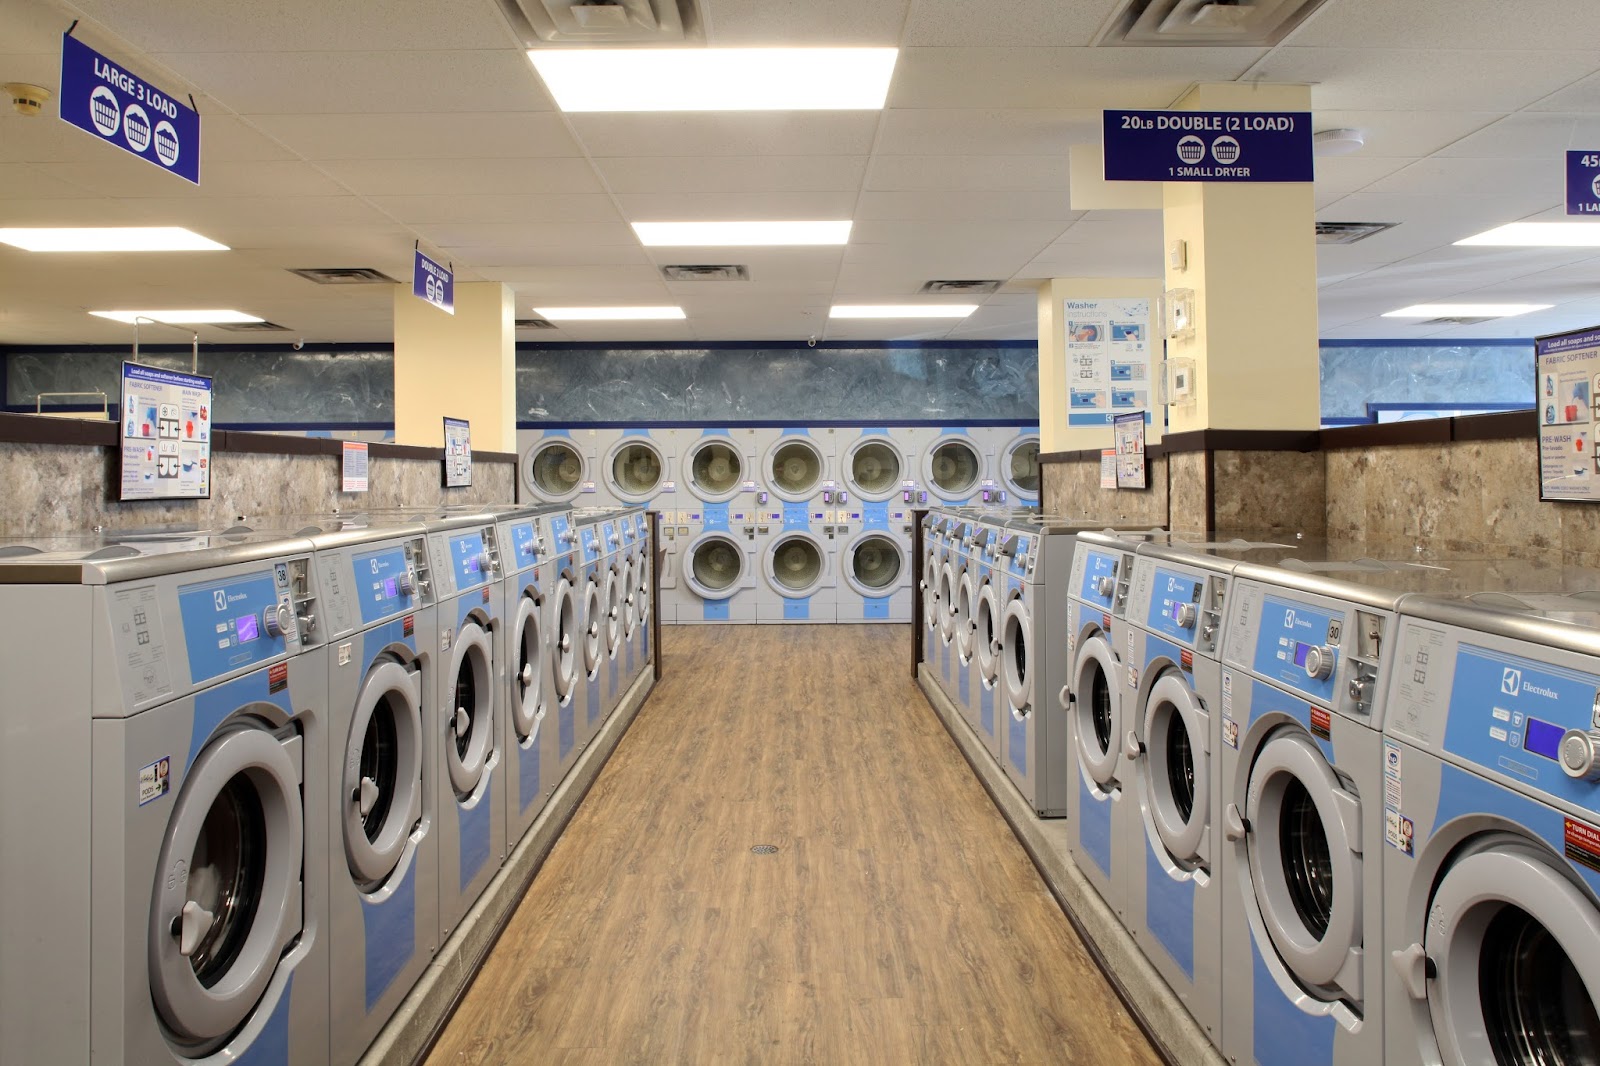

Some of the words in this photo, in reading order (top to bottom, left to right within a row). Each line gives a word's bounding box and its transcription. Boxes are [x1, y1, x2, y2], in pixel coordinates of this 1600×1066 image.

[94, 57, 135, 96] LARGE
[137, 84, 144, 101] 3
[146, 89, 177, 119] LOAD
[1121, 116, 1154, 129] 20LB
[1157, 116, 1222, 131] DOUBLE
[1225, 117, 1241, 132] (2
[1244, 117, 1294, 133] LOAD)
[1169, 167, 1174, 176] 1
[1177, 167, 1213, 177] SMALL
[1215, 167, 1250, 177] DRYER
[1578, 203, 1583, 211] 1
[1547, 340, 1560, 349] Load
[1568, 337, 1583, 345] soaps
[1583, 334, 1594, 342] and
[1545, 356, 1566, 365] FABRIC
[1567, 351, 1598, 362] SOFTENER
[278, 570, 287, 581] 38
[1330, 626, 1339, 639] 30
[1523, 681, 1558, 700] Electrolux
[1572, 823, 1587, 836] TURN
[1587, 831, 1600, 841] DIAL
